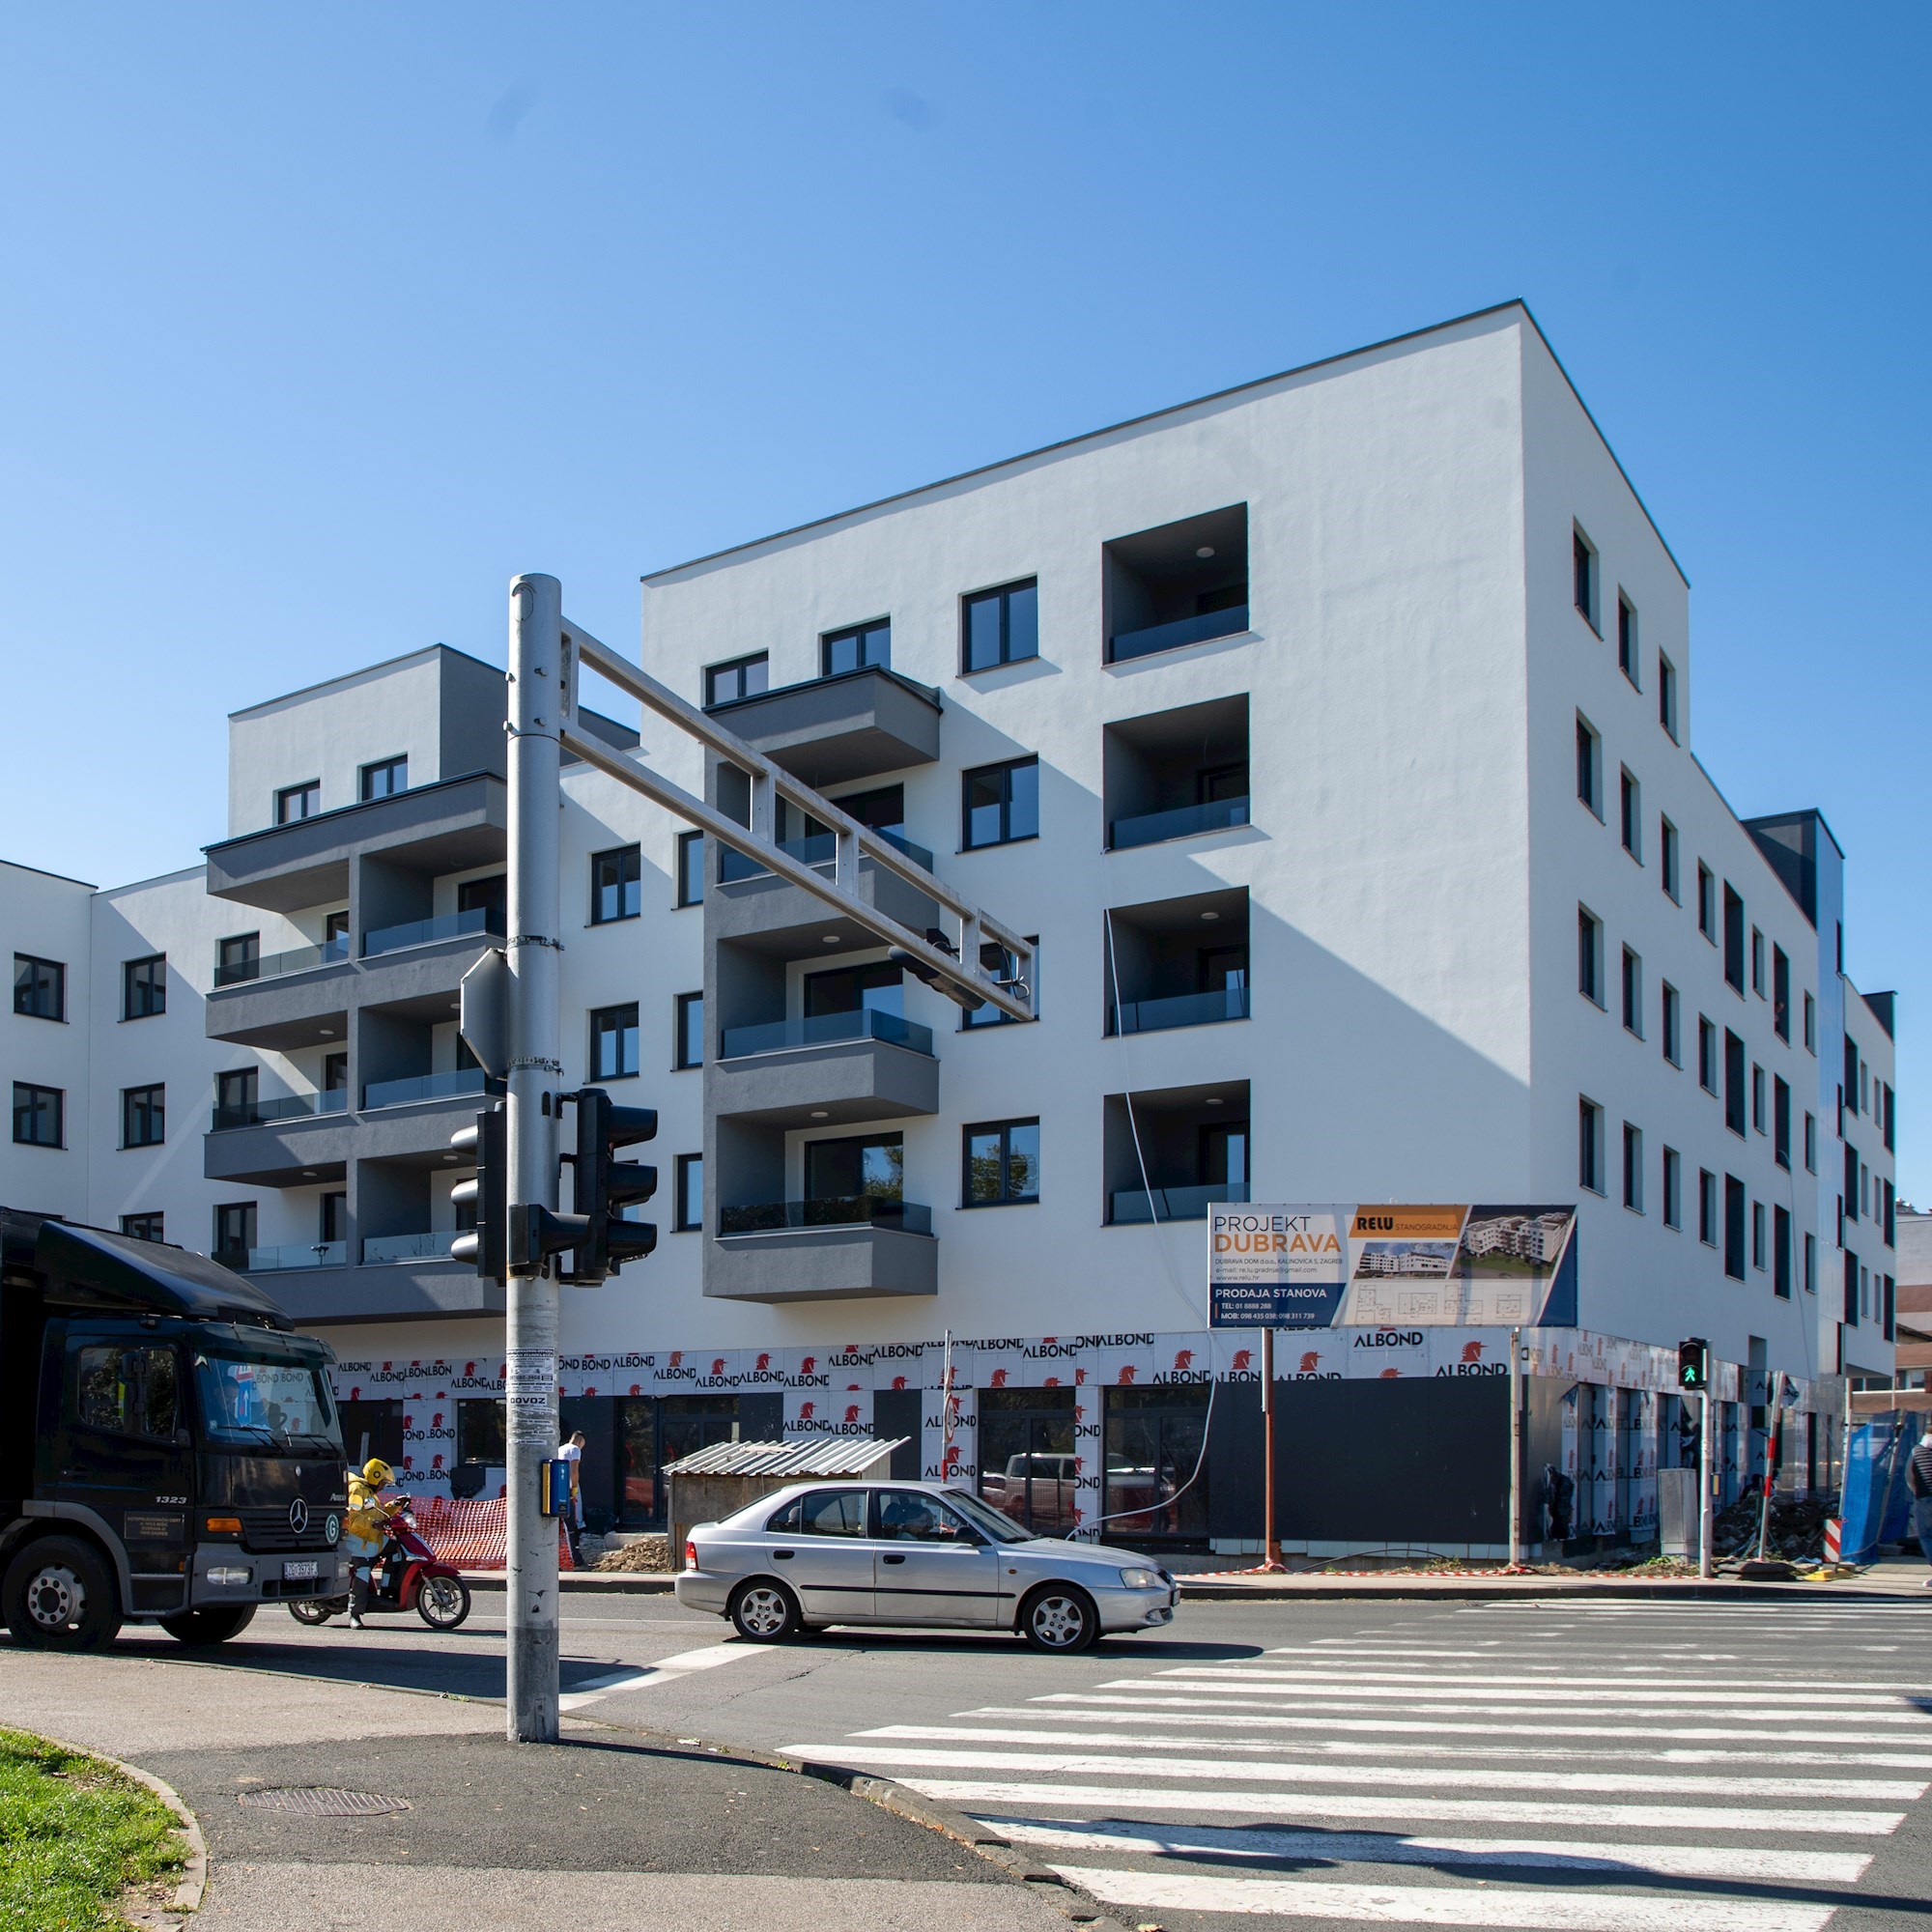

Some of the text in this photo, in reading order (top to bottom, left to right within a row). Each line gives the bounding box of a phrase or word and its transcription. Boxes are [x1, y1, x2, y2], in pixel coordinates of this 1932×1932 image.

[1214, 1216, 1311, 1232] PROJEKT
[1357, 1217, 1393, 1230] RELU
[1214, 1234, 1342, 1253] DUBRAVA
[1215, 1289, 1327, 1298] PRODAJA STANOVA
[973, 1339, 1024, 1350] ALBOND
[1097, 1333, 1154, 1348] ALBOND
[1353, 1332, 1423, 1348] ALBOND
[873, 1345, 923, 1358] ALBOND
[1023, 1344, 1076, 1358] ALBOND
[613, 1355, 654, 1368] ALBOND
[829, 1353, 874, 1367] ALBOND
[338, 1362, 371, 1372] ALBOND
[654, 1367, 696, 1380] ALBOND
[1435, 1363, 1508, 1377] ALBOND
[370, 1372, 404, 1382] ALBOND
[451, 1378, 486, 1388] ALBOND
[696, 1376, 739, 1388] ALBOND
[739, 1370, 783, 1383] ALBOND
[783, 1374, 829, 1387] ALBOND
[1153, 1370, 1209, 1384] ALBOND
[783, 1420, 829, 1432] ALBOND
[924, 1415, 977, 1428] ALOND
[829, 1423, 874, 1435] ALBOND
[156, 1495, 187, 1504] 1323
[329, 1520, 336, 1537] G
